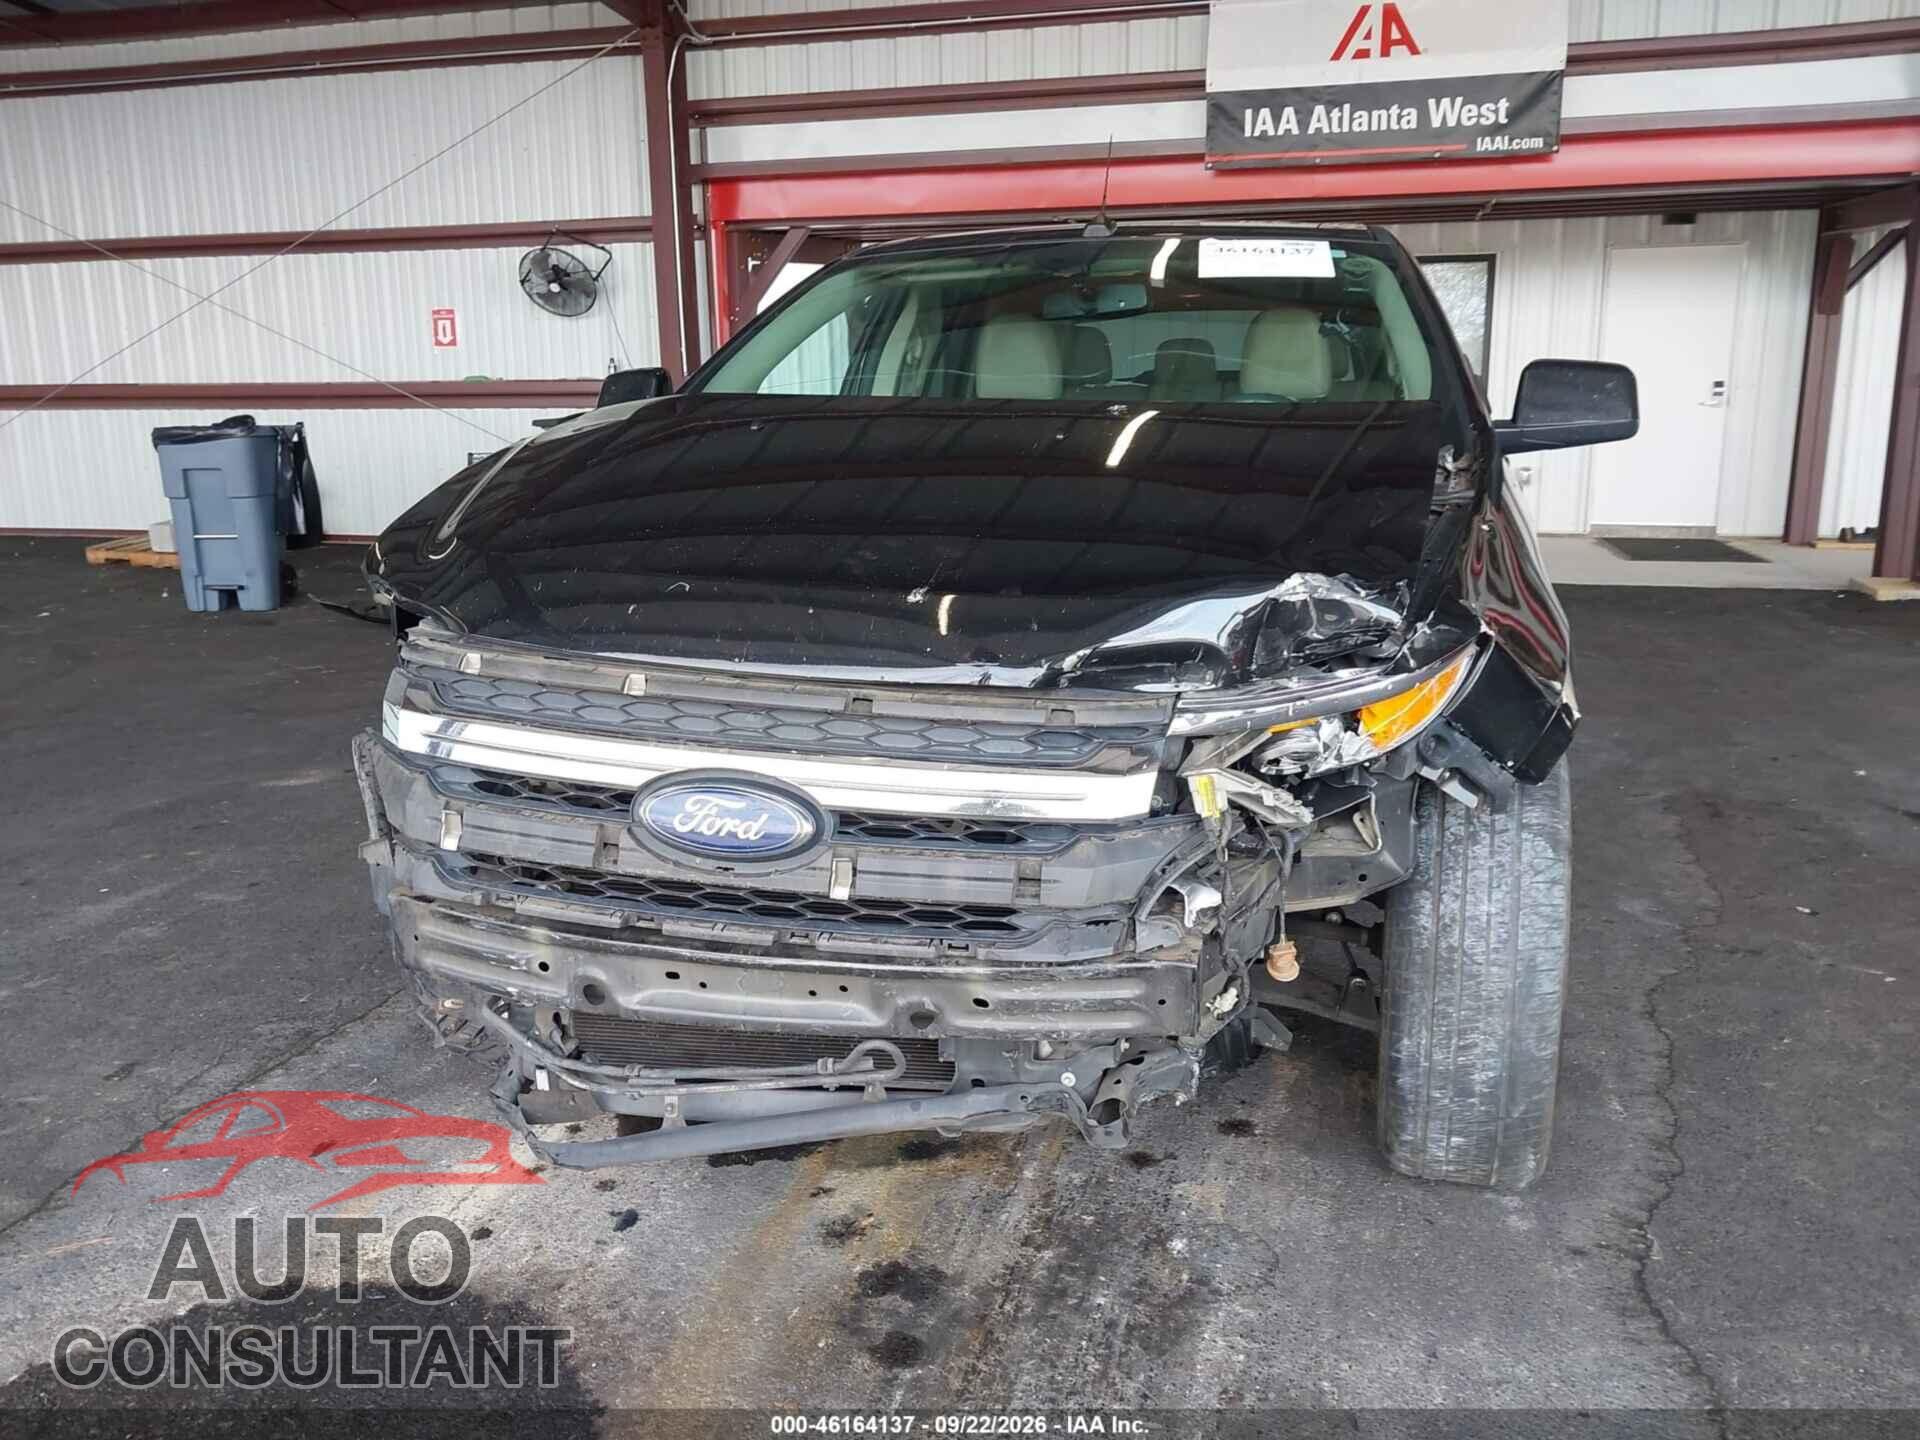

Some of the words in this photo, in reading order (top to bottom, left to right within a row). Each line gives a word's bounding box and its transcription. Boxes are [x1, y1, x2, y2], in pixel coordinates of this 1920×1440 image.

[1243, 107, 1299, 138] IAA
[1307, 103, 1418, 135] Atlanta
[1427, 96, 1510, 128] West
[1476, 135, 1544, 152] IAAI.com
[673, 795, 769, 841] Ford
